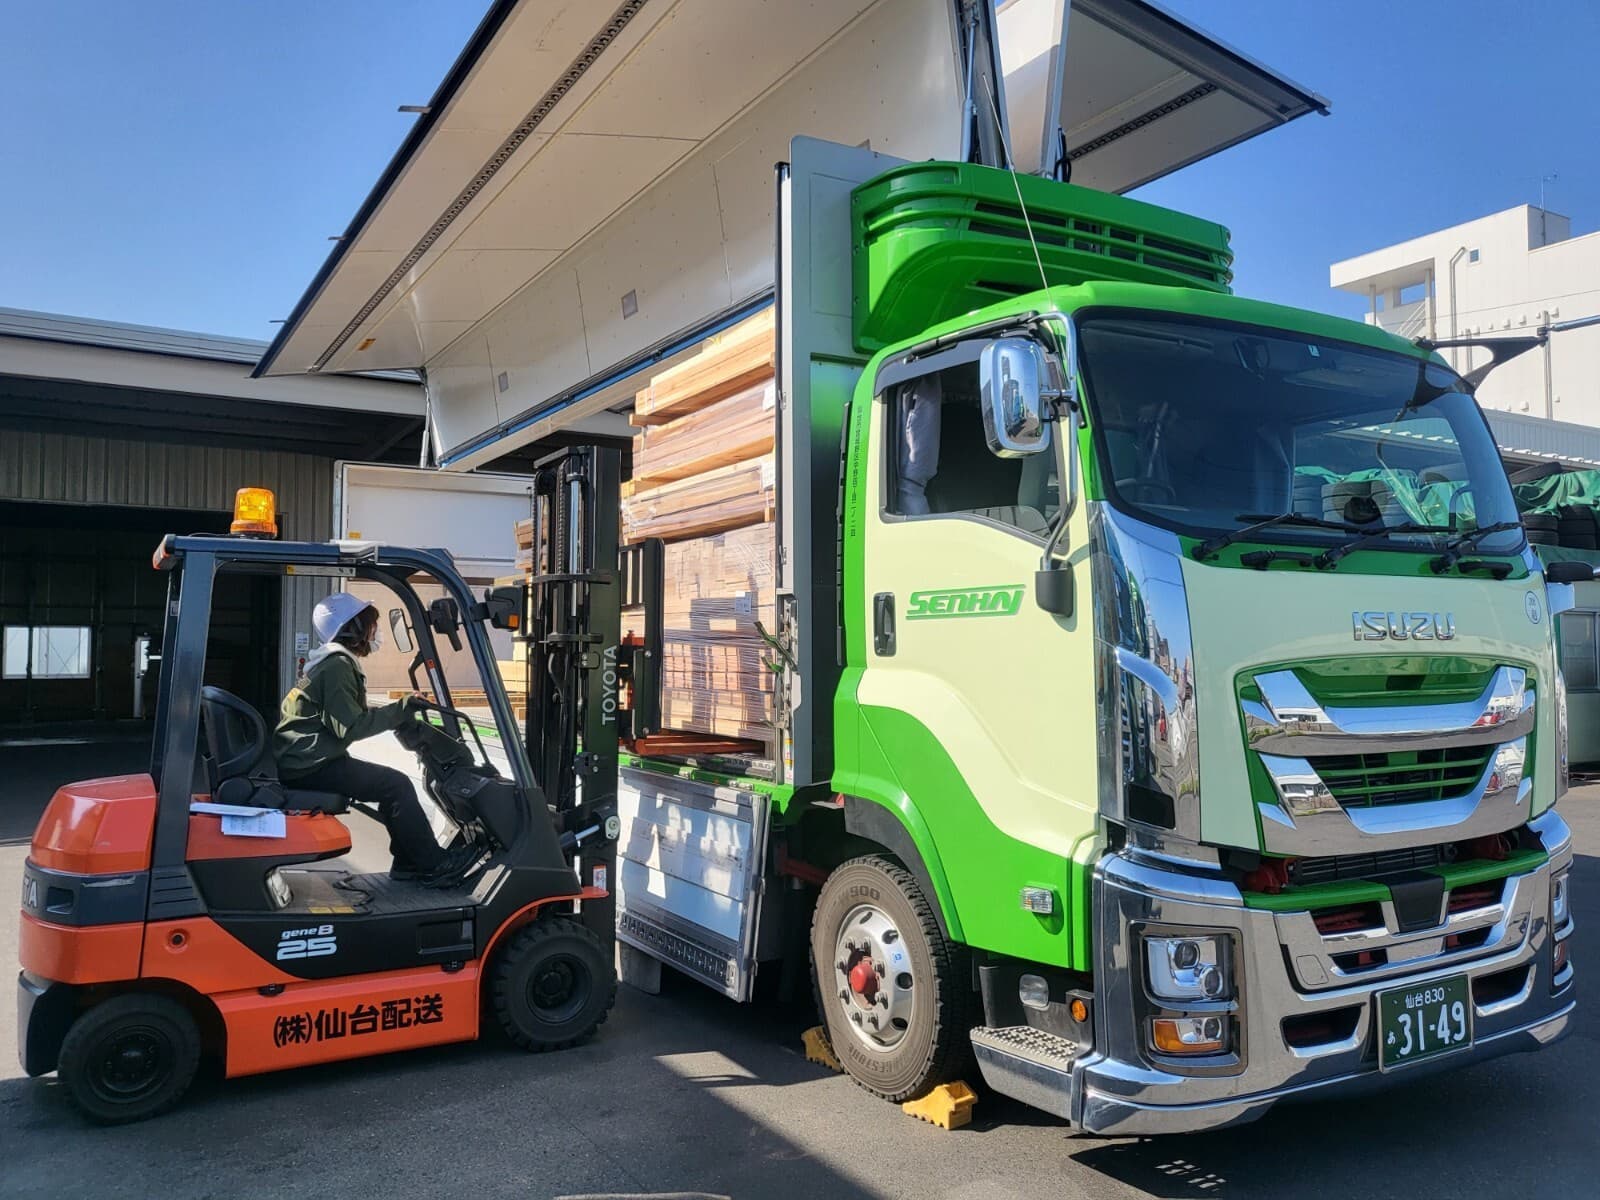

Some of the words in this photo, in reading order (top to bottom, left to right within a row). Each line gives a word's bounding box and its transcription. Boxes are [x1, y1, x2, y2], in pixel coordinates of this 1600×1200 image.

[1352, 611, 1456, 641] ISUZU
[601, 645, 618, 726] TOYOTA
[276, 936, 337, 961] 25
[273, 993, 443, 1048] (株)仙台配送
[1397, 1001, 1466, 1056] 31-49
